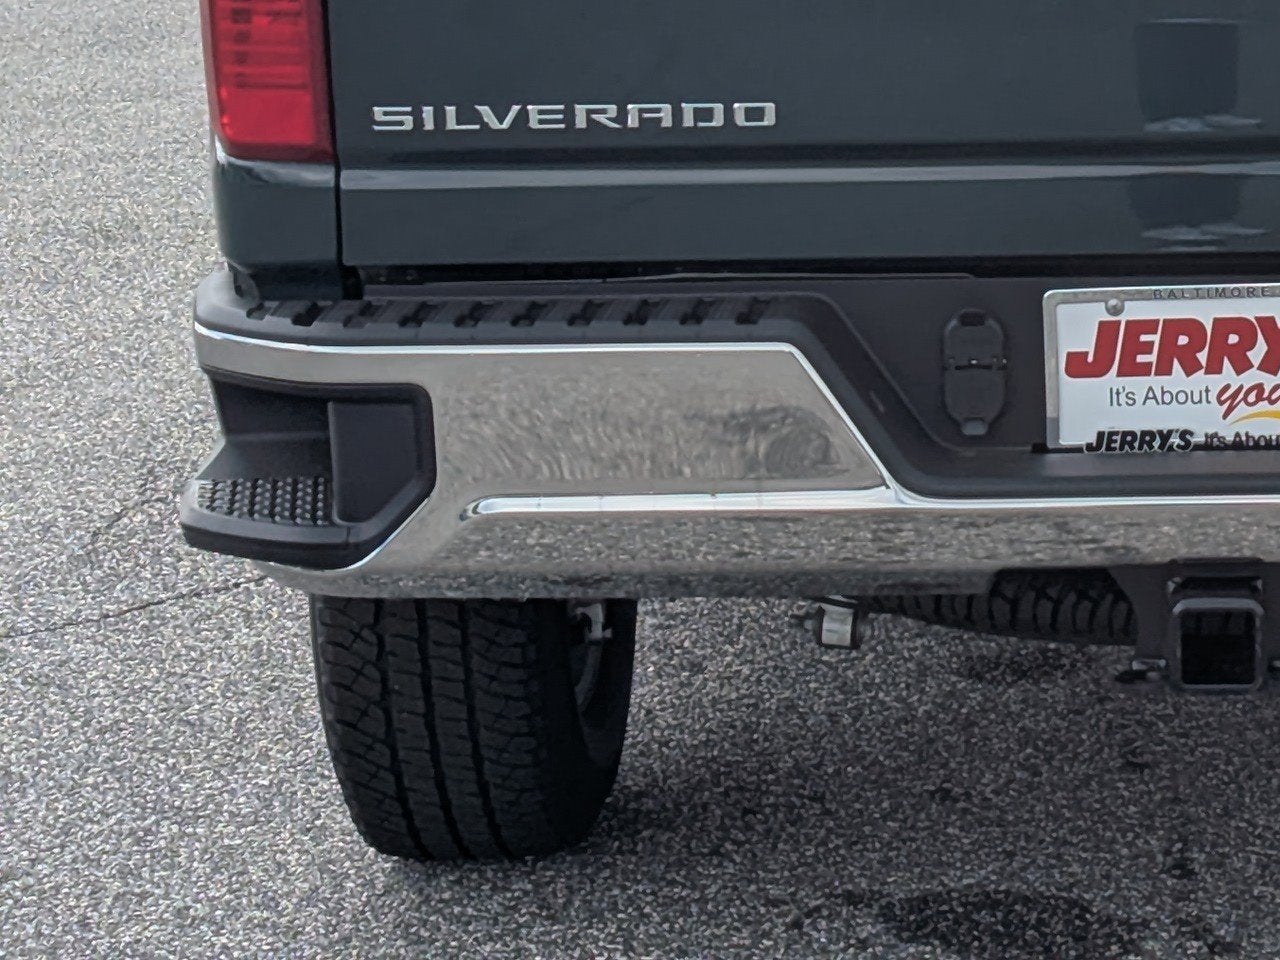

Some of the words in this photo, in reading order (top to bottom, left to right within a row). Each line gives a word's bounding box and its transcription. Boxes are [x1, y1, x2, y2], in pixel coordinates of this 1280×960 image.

[371, 102, 777, 131] SILVERADO
[1152, 286, 1271, 300] BALTIMORE
[1108, 386, 1137, 407] It's
[1142, 385, 1211, 406] About
[1085, 428, 1195, 453] JERRY'S
[1204, 430, 1227, 448] It's
